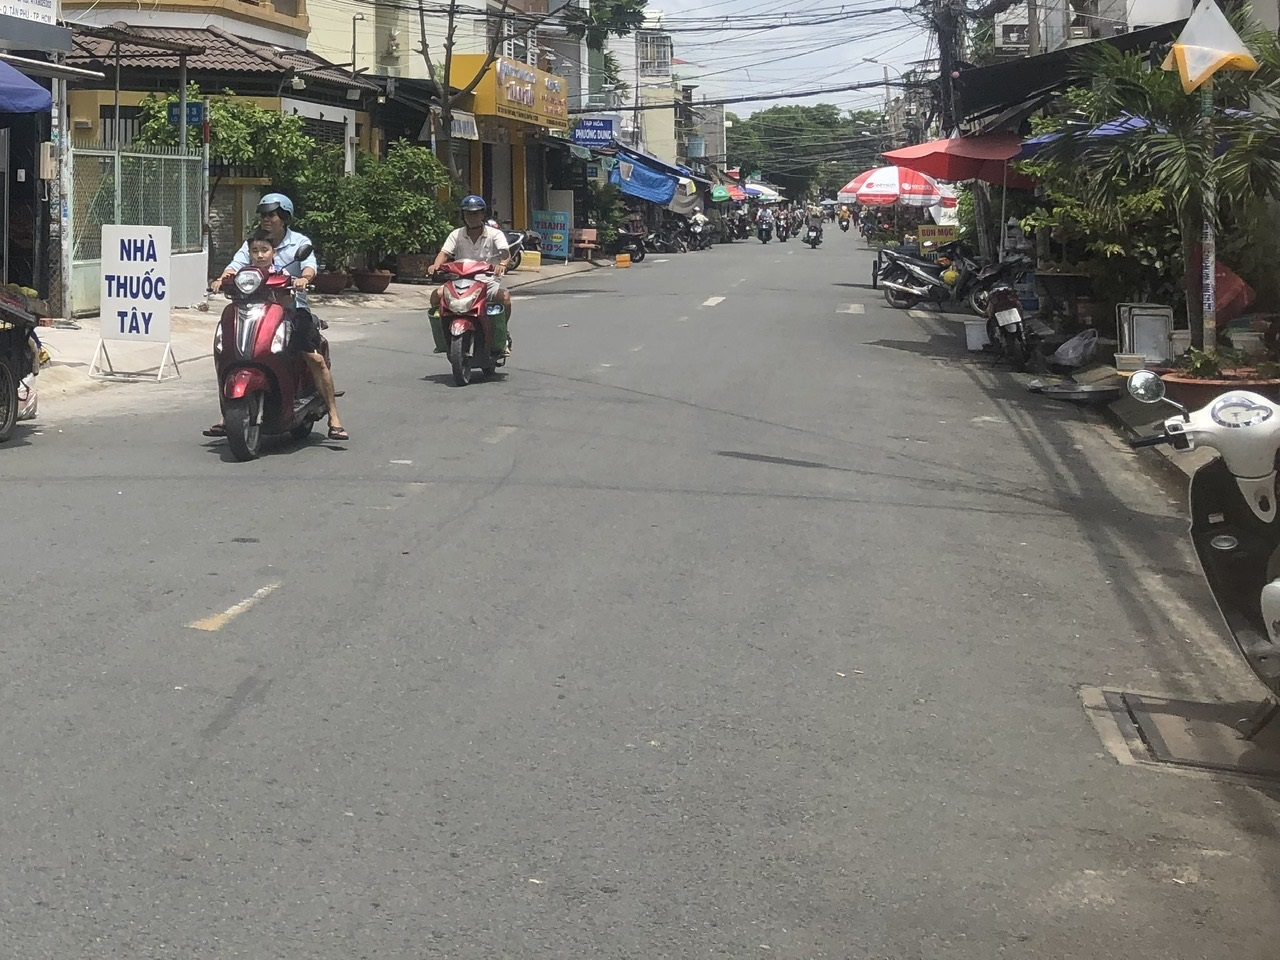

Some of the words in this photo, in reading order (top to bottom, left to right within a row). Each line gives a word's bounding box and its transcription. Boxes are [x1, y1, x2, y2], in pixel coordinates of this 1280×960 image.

[597, 130, 612, 140] DUNG
[120, 234, 157, 262] NHÀ
[104, 268, 166, 300] THUỐC
[117, 306, 153, 335] TÂY
